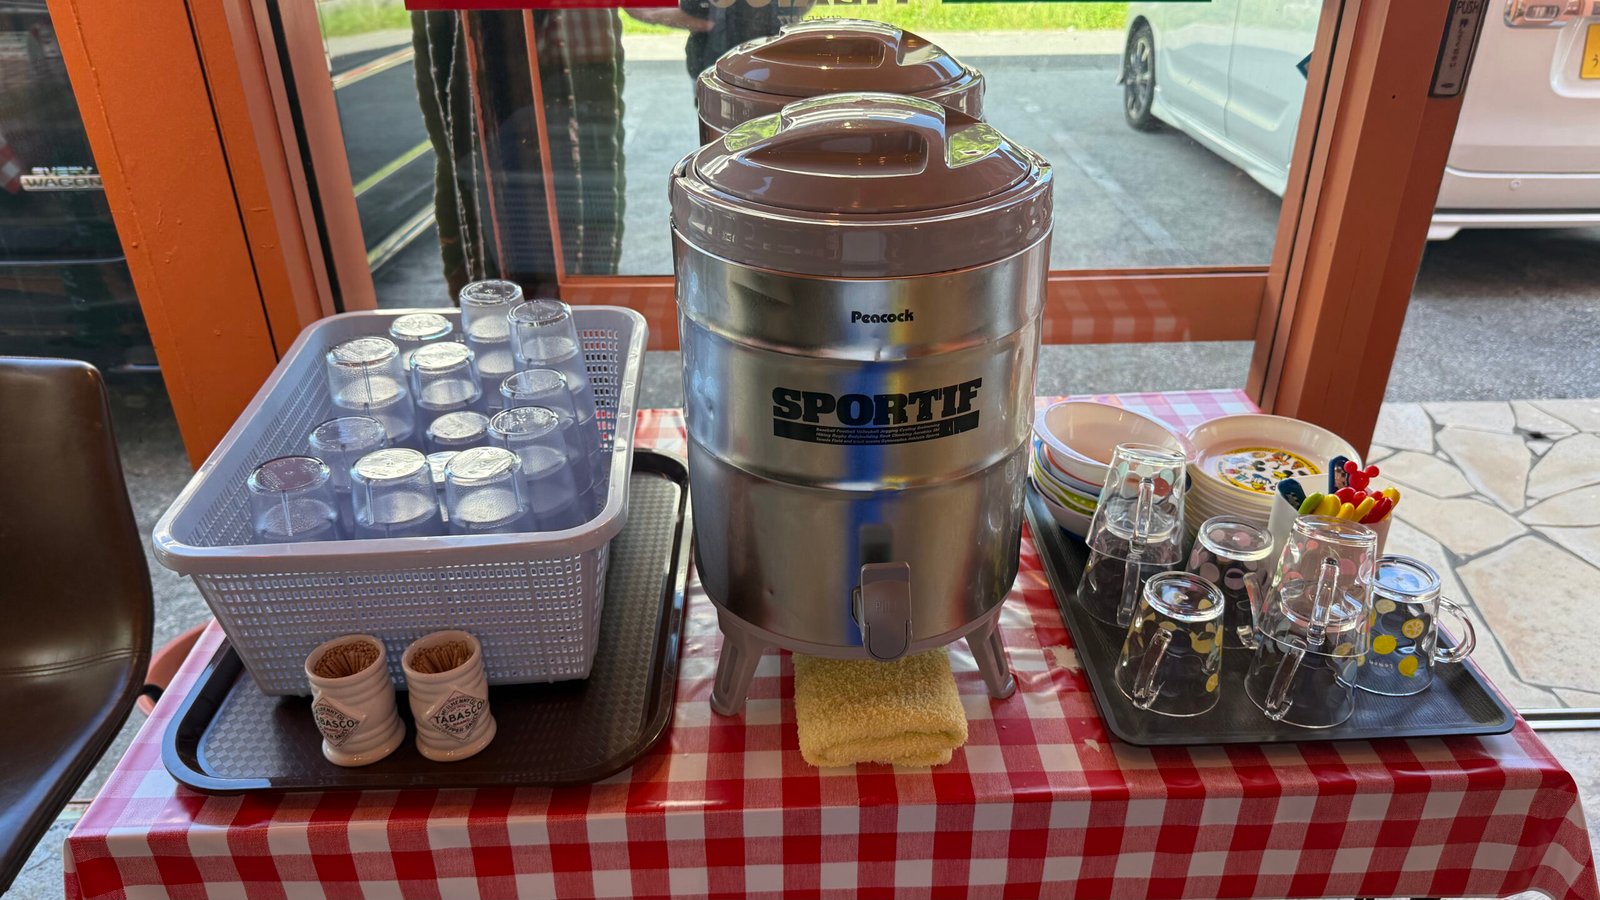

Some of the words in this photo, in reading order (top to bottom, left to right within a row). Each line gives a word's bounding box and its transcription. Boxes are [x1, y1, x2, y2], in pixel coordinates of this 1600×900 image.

[1456, 0, 1479, 14] PUSH
[25, 177, 103, 188] WAGON
[851, 309, 914, 324] Peacock
[772, 377, 983, 425] SPORTIF
[433, 700, 483, 726] TABASCO
